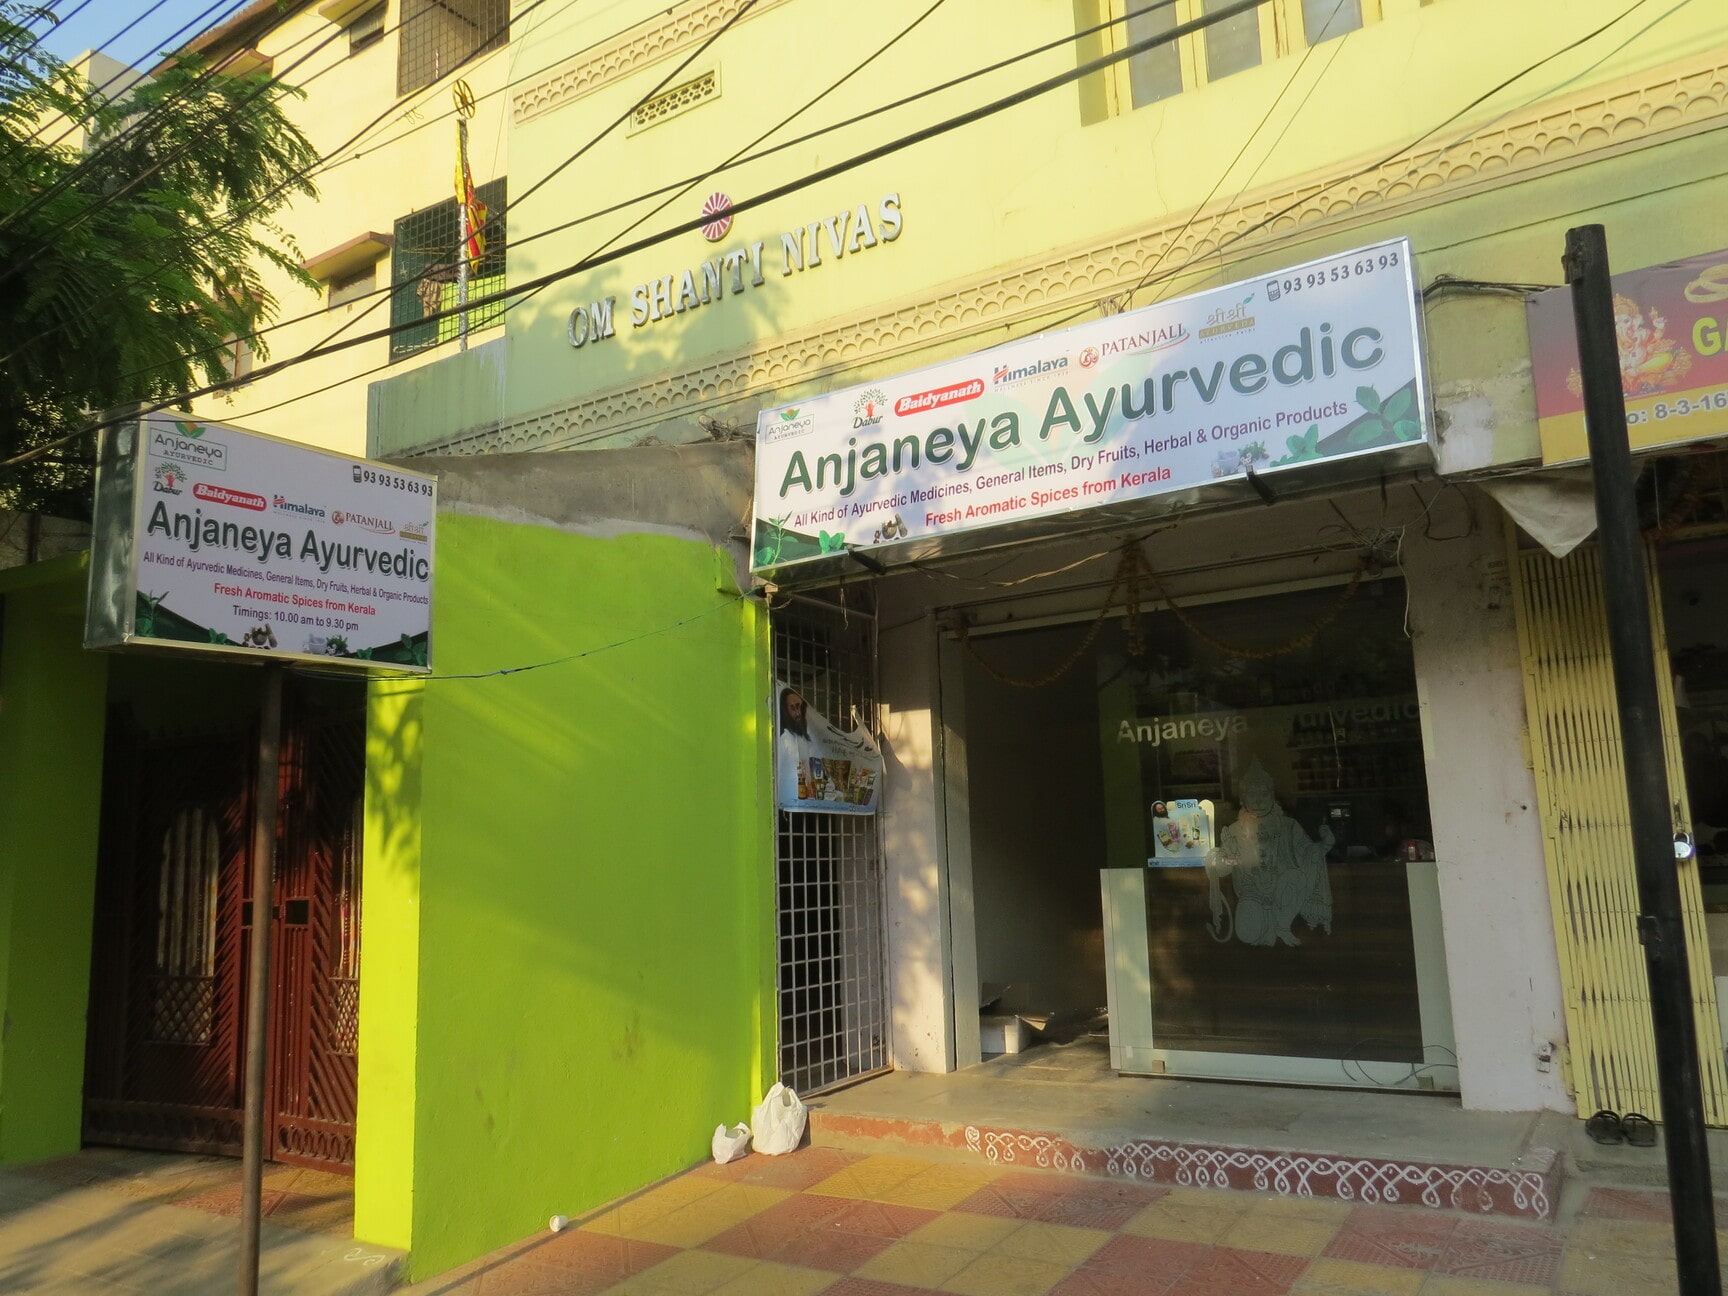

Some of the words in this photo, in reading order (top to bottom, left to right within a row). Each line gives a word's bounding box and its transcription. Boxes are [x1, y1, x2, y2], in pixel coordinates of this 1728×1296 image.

[567, 296, 616, 348] OM
[630, 241, 765, 328] SHANTI
[780, 193, 904, 276] NIVAS
[1283, 278, 1302, 295] 93
[1306, 272, 1325, 289] 93
[1330, 266, 1350, 282] 53
[1354, 259, 1374, 276] 63
[1379, 252, 1399, 269] 93
[1101, 323, 1185, 356] PATANJALI
[1692, 315, 1728, 356] G
[993, 356, 1068, 385] Himalaya
[779, 410, 1022, 498] Anjaneya
[1038, 321, 1384, 444] Ayurvedic
[898, 382, 983, 414] Baidyanath
[1654, 392, 1728, 420] 8-3-16
[768, 418, 811, 436] Anjaneya
[853, 415, 883, 429] Dabur
[154, 433, 223, 459] Anjaneya
[163, 449, 214, 466] AYURVEDIC
[794, 513, 808, 528] All
[810, 508, 835, 525] Kind
[837, 503, 849, 518] of
[851, 494, 908, 516] Ayurvedic
[910, 479, 973, 504] Medicines,
[975, 469, 1025, 491] General
[1028, 460, 1067, 478] Items,
[1071, 454, 1094, 472] Dry
[1098, 444, 1140, 464] Fruits,
[1144, 431, 1192, 454] Herbal
[1196, 429, 1208, 444] &
[1211, 418, 1272, 441] Organic
[1275, 401, 1348, 428] Products
[153, 481, 183, 496] Dabur
[195, 484, 265, 509] Baidyanath
[363, 470, 376, 484] 93
[379, 475, 391, 487] 93
[393, 477, 405, 490] 53
[407, 480, 420, 494] 63
[421, 484, 433, 497] 93
[925, 510, 962, 527] Fresh
[965, 496, 1027, 519] Aromatic
[1030, 485, 1079, 507] Spices
[1082, 479, 1116, 496] from
[1121, 467, 1171, 487] Kerala
[273, 494, 325, 518] Himalaya
[345, 512, 393, 531] PATANJALI
[147, 500, 292, 563] Anjaneya
[300, 529, 430, 582] Ayurvedic
[143, 551, 155, 563] All
[156, 554, 175, 566] Kind
[176, 557, 185, 568] of
[186, 558, 225, 574] Ayurvedic
[226, 565, 265, 582] Medicines,
[266, 570, 294, 586] General
[295, 576, 315, 589] Items,
[316, 578, 329, 592] Dry
[329, 581, 349, 595] Fruits,
[350, 584, 371, 597] Herbal
[372, 588, 378, 597] &
[378, 588, 402, 601] Organic
[403, 592, 429, 605] Products
[214, 582, 243, 598] Fresh
[245, 588, 290, 605] Aromatic
[291, 594, 323, 609] Spices
[325, 599, 346, 613] from
[348, 602, 376, 616] Kerala
[232, 604, 272, 622] Timings:
[274, 611, 298, 625] 10.00
[300, 615, 314, 626] am
[316, 616, 325, 627] to
[326, 617, 344, 630] 9.30
[346, 621, 359, 632] pm
[1116, 714, 1248, 747] Anjaneya
